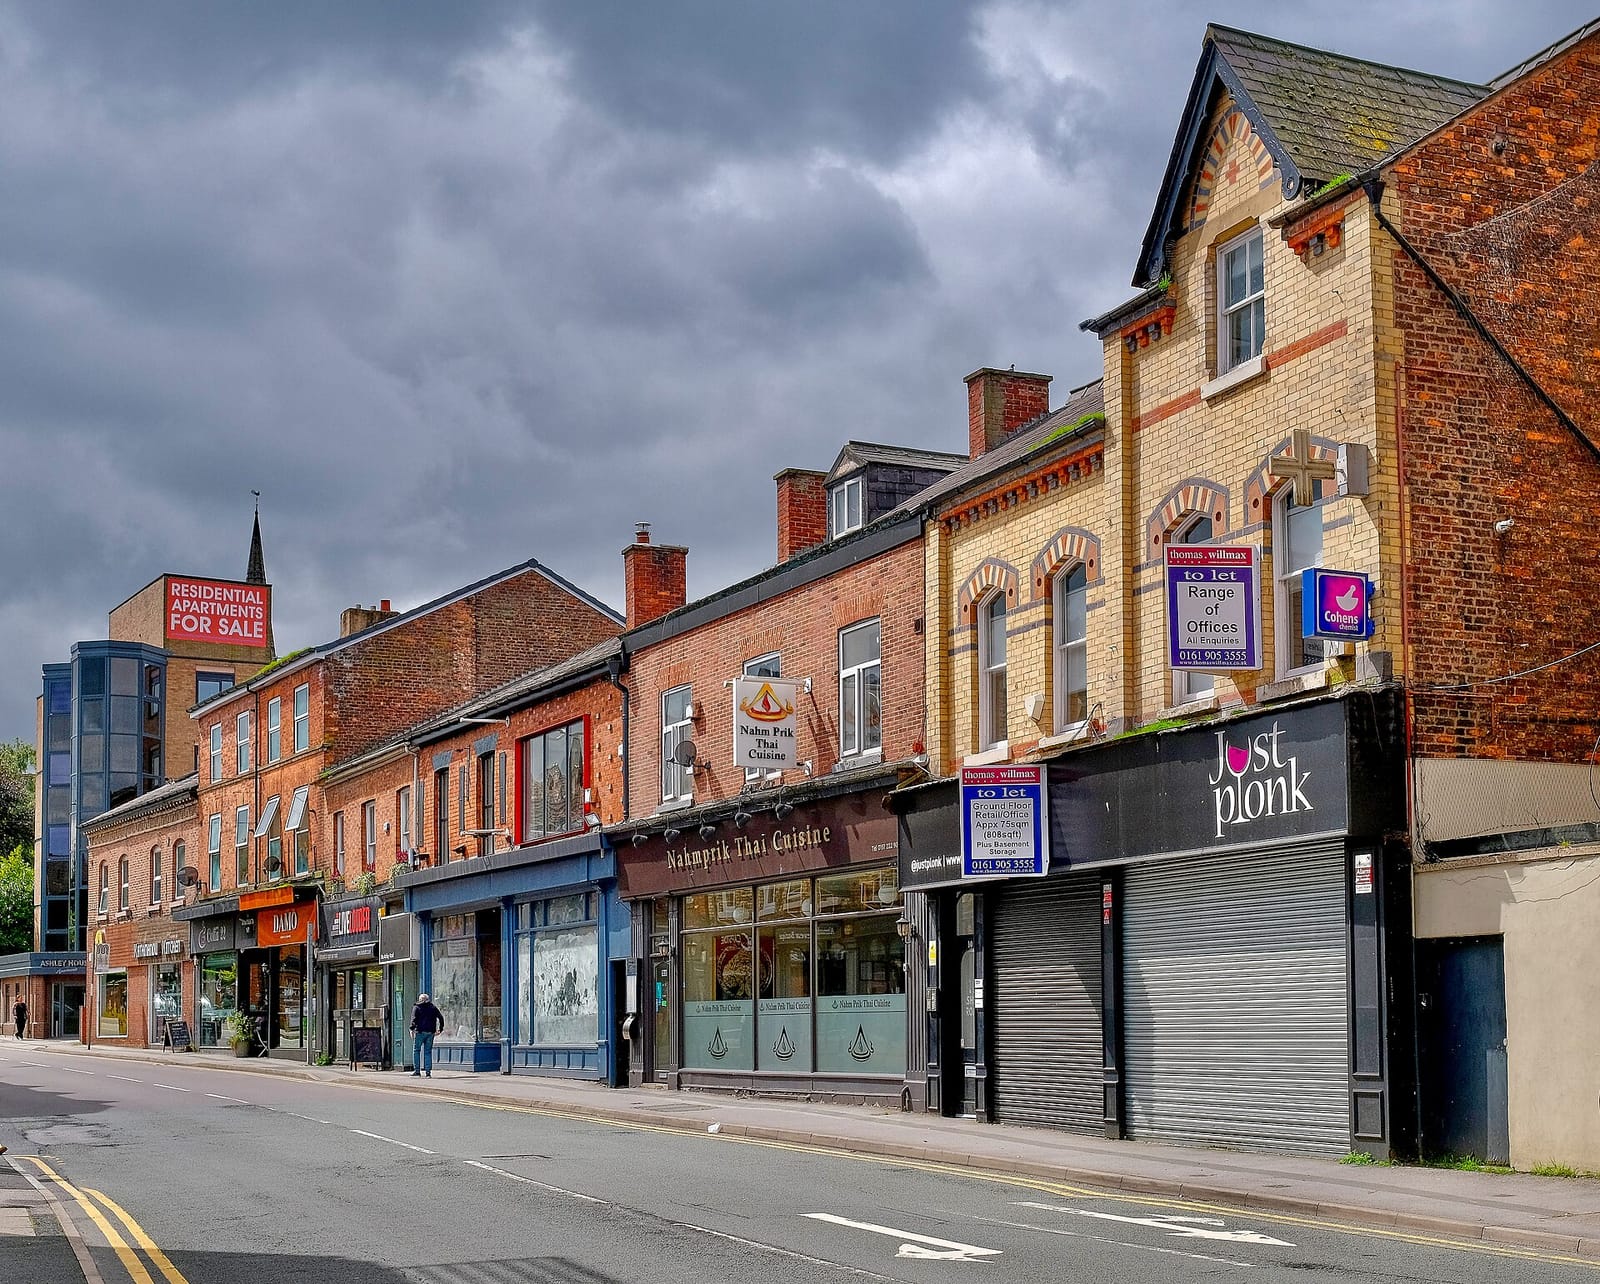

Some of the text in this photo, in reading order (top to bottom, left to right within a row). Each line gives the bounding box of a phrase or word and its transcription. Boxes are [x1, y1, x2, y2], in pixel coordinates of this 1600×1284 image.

[1208, 550, 1246, 560] willmax
[1184, 570, 1237, 580] to let
[171, 582, 263, 604] RESIDENTIAL
[1188, 586, 1234, 601] Range
[172, 598, 263, 620] APARTMENTS
[1205, 603, 1220, 616] of
[1324, 610, 1358, 624] Cohens
[170, 614, 263, 638] FOR SALE
[1187, 620, 1238, 632] Offices
[1200, 636, 1240, 645] Enquiries
[1180, 651, 1246, 660] 0161 905 3555
[740, 726, 794, 738] Nahm Prik
[756, 738, 778, 748] Thai
[748, 748, 786, 760] Cuisine
[1208, 720, 1286, 785] Just
[1000, 770, 1036, 778] willmax
[978, 788, 1026, 798] to let
[1212, 756, 1314, 838] plonk
[972, 802, 1032, 810] Ground Floor
[976, 811, 1029, 819] Retail/Office
[976, 820, 1029, 830] Appx 75sqm
[984, 831, 1022, 840] (808sqft)
[666, 826, 831, 870] Nahmprik Thai Cuisine
[972, 860, 1034, 870] 0161 905 3555
[273, 911, 298, 933] DAMO
